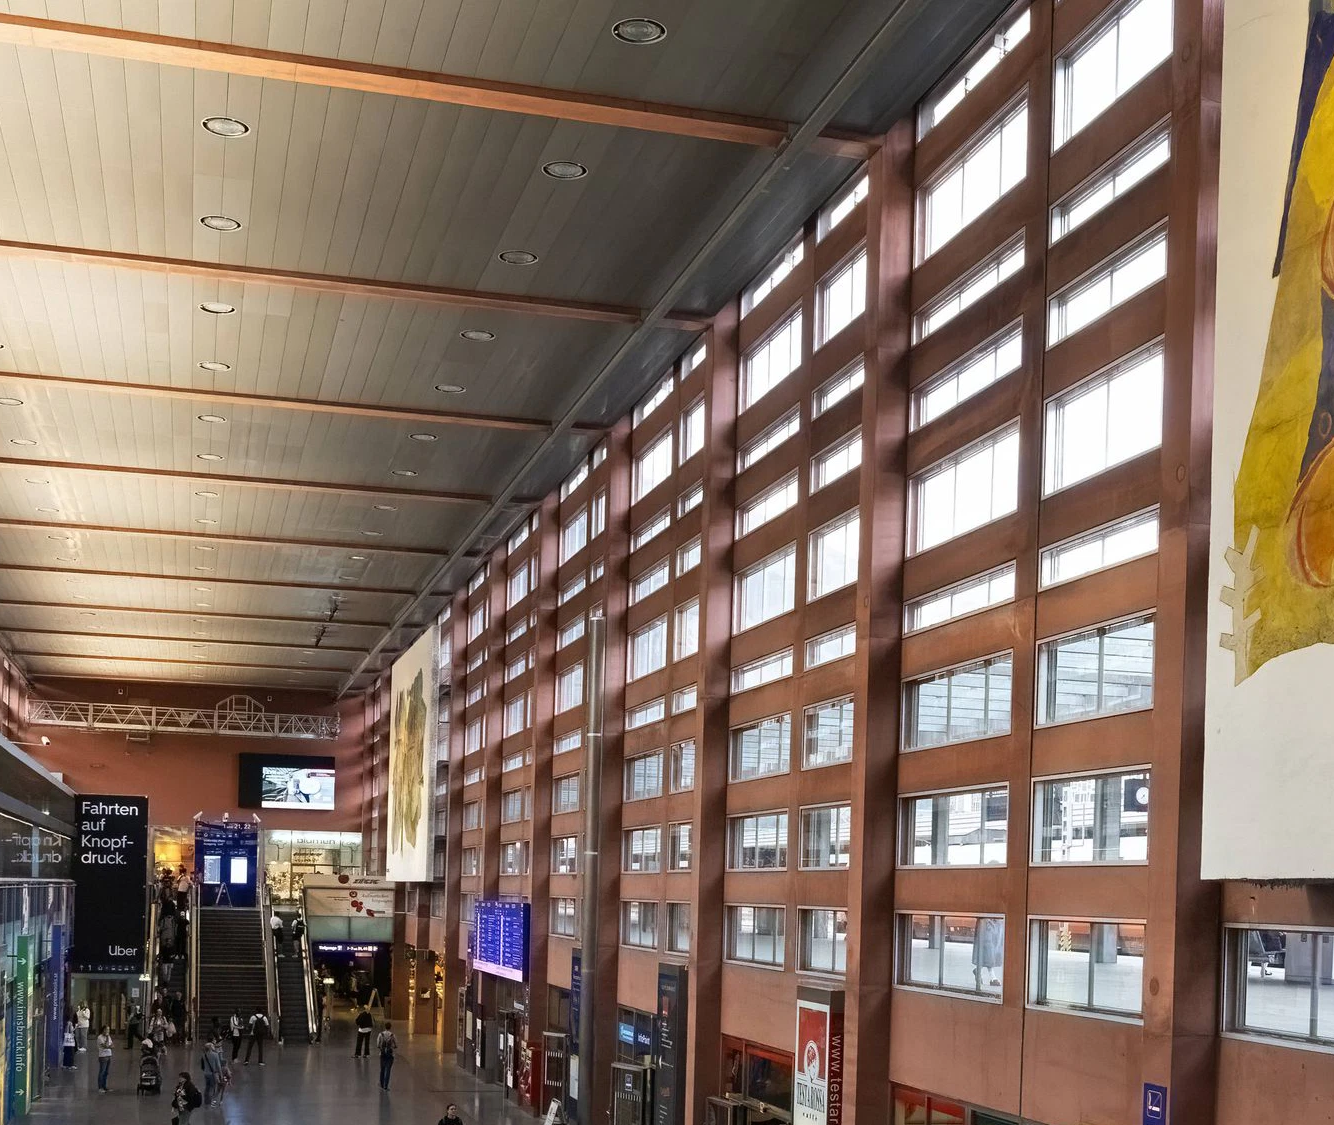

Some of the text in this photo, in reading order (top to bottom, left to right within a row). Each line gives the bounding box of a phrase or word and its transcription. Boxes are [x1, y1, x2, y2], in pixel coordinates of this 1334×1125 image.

[82, 801, 139, 816] Fahrten
[81, 820, 106, 831] auf
[81, 835, 134, 850] Knopf-
[81, 851, 127, 865] druck.
[108, 945, 138, 956] Uber
[16, 981, 25, 1072] www.innsbruck.info
